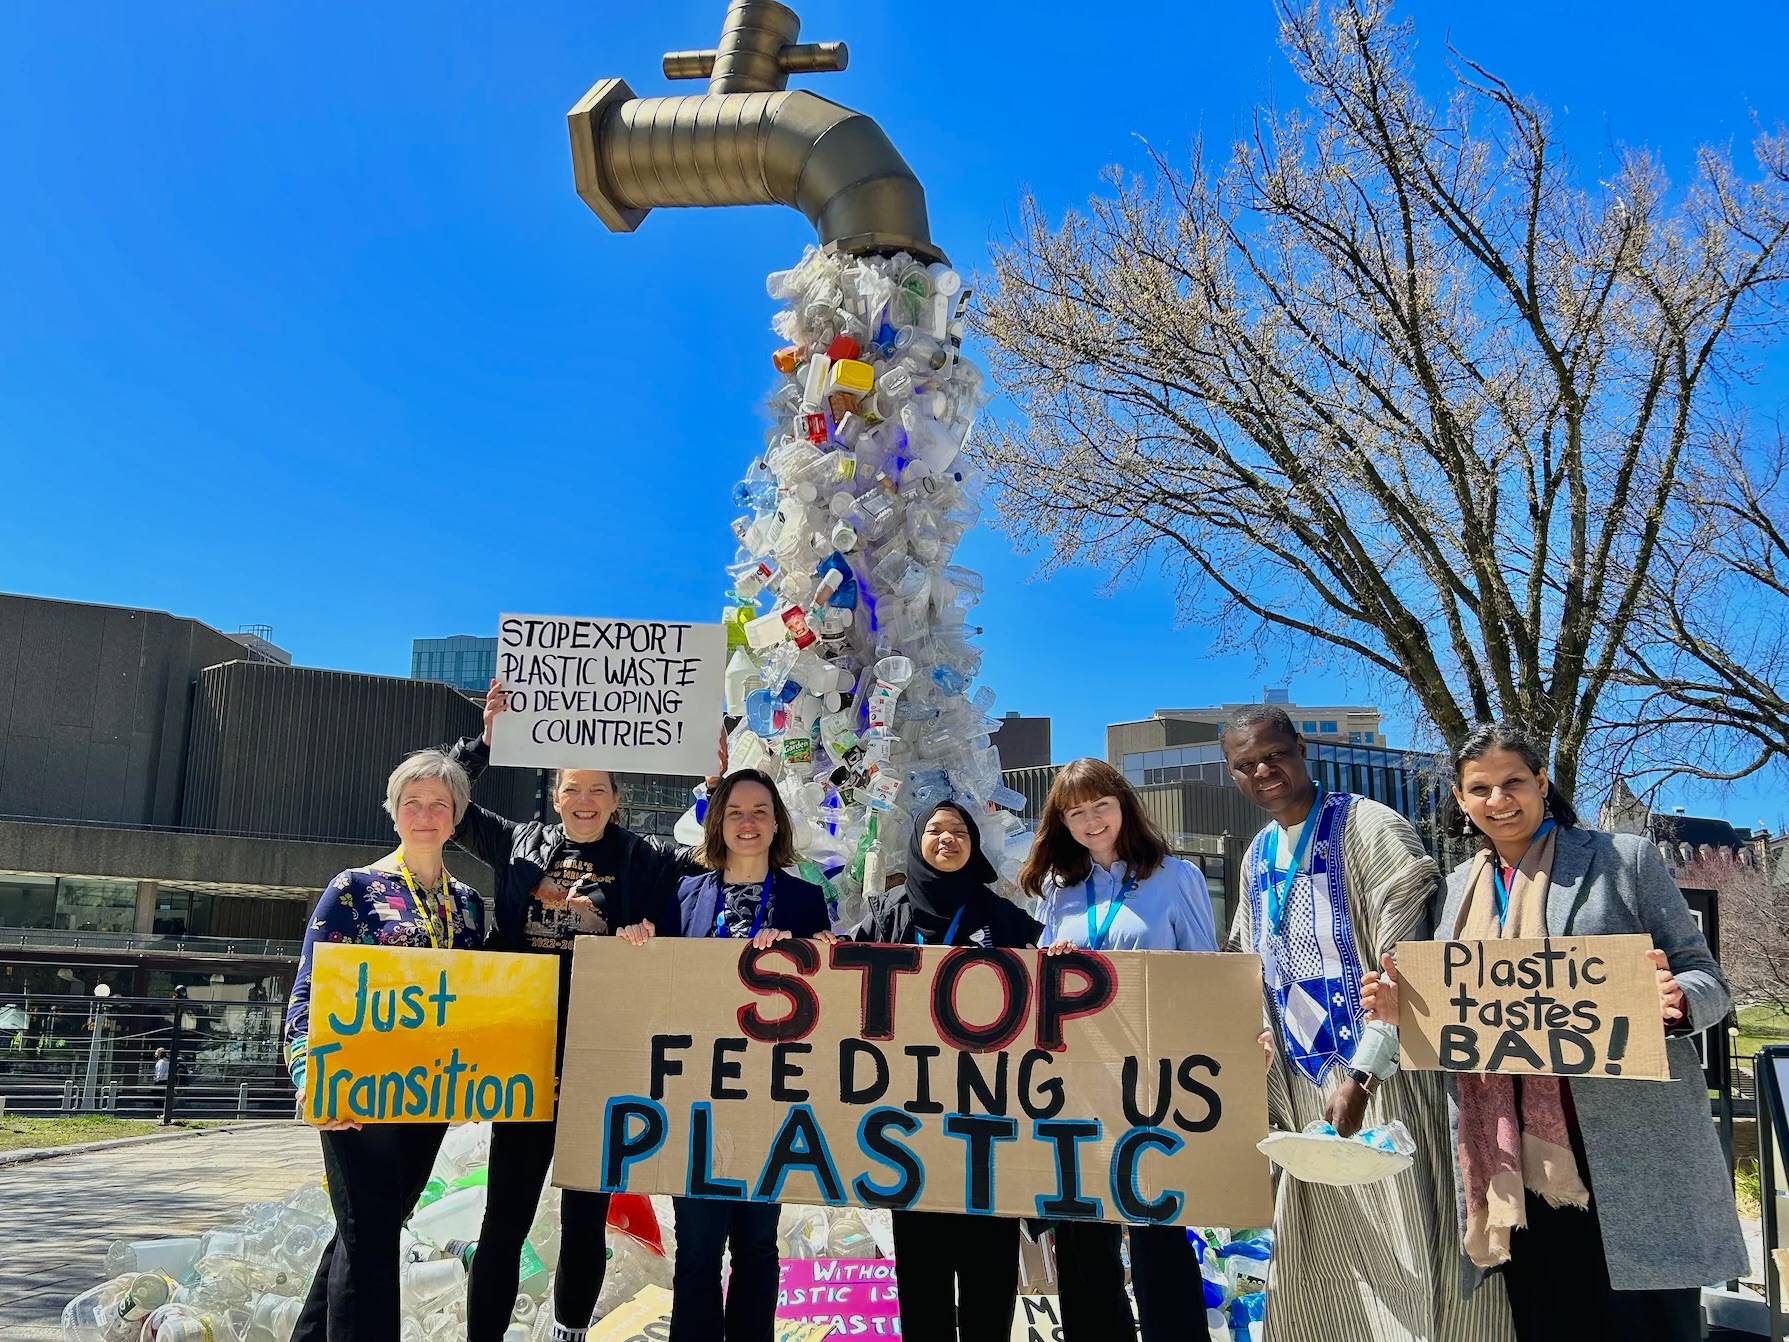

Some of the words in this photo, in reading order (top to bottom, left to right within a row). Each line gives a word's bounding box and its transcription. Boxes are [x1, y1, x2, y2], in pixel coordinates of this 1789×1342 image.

[501, 652, 597, 687] PLASTIC
[604, 656, 701, 687] WASTE
[498, 690, 527, 712] TO
[534, 689, 683, 715] DEVELOPING
[532, 719, 683, 746] COUNTRIES!
[784, 740, 809, 753] Garden
[531, 937, 574, 950] 2022-20
[1443, 938, 1608, 990] Plastic
[328, 961, 457, 1036] Just
[737, 938, 1119, 1054] STOP
[1450, 982, 1601, 1034] tastes
[1439, 1016, 1629, 1076] BAD!
[309, 1041, 534, 1120] Transition
[650, 1034, 1066, 1120] FEEDING
[1121, 1055, 1222, 1133] US
[600, 1094, 1185, 1223] PLASTIC
[776, 1286, 852, 1307] ASTIC
